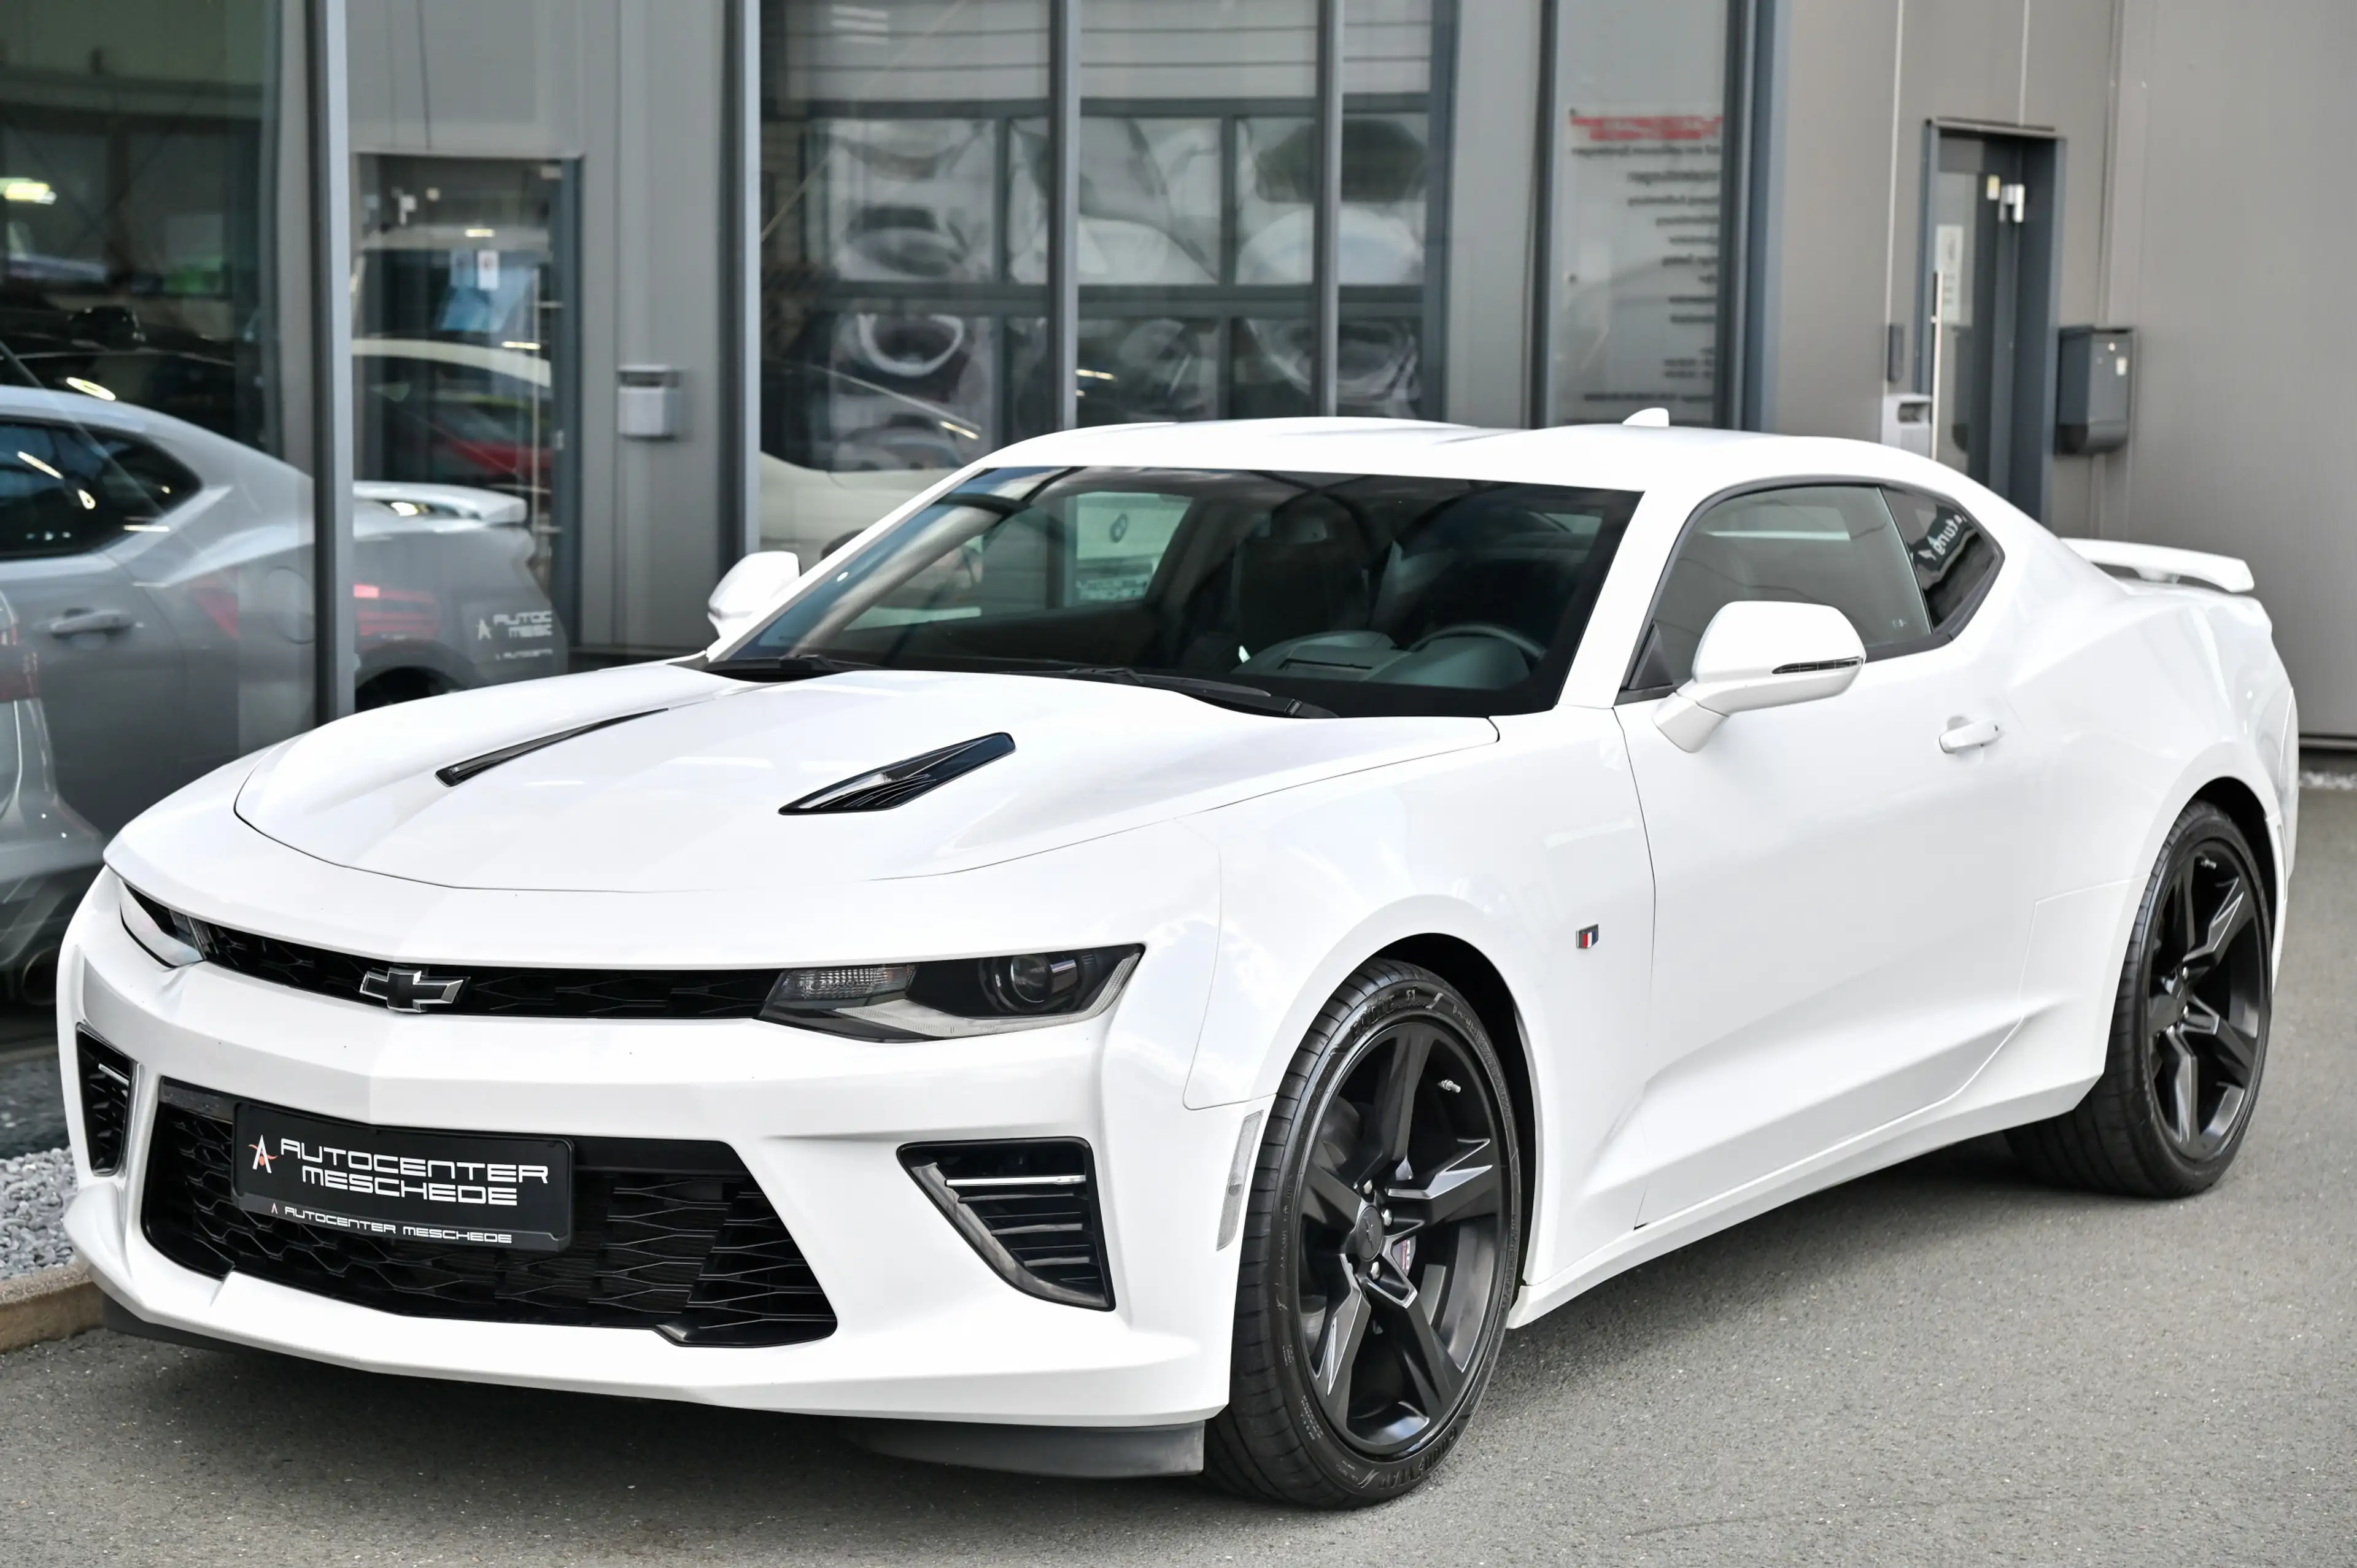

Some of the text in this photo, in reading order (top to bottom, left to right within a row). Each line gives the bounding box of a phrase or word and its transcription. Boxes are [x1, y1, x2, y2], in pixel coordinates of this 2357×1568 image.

[281, 1138, 548, 1184] AUTOCENTER
[302, 1165, 517, 1206] MESCHEDE
[285, 1206, 512, 1244] AUTOCENTER MESCHEDE
